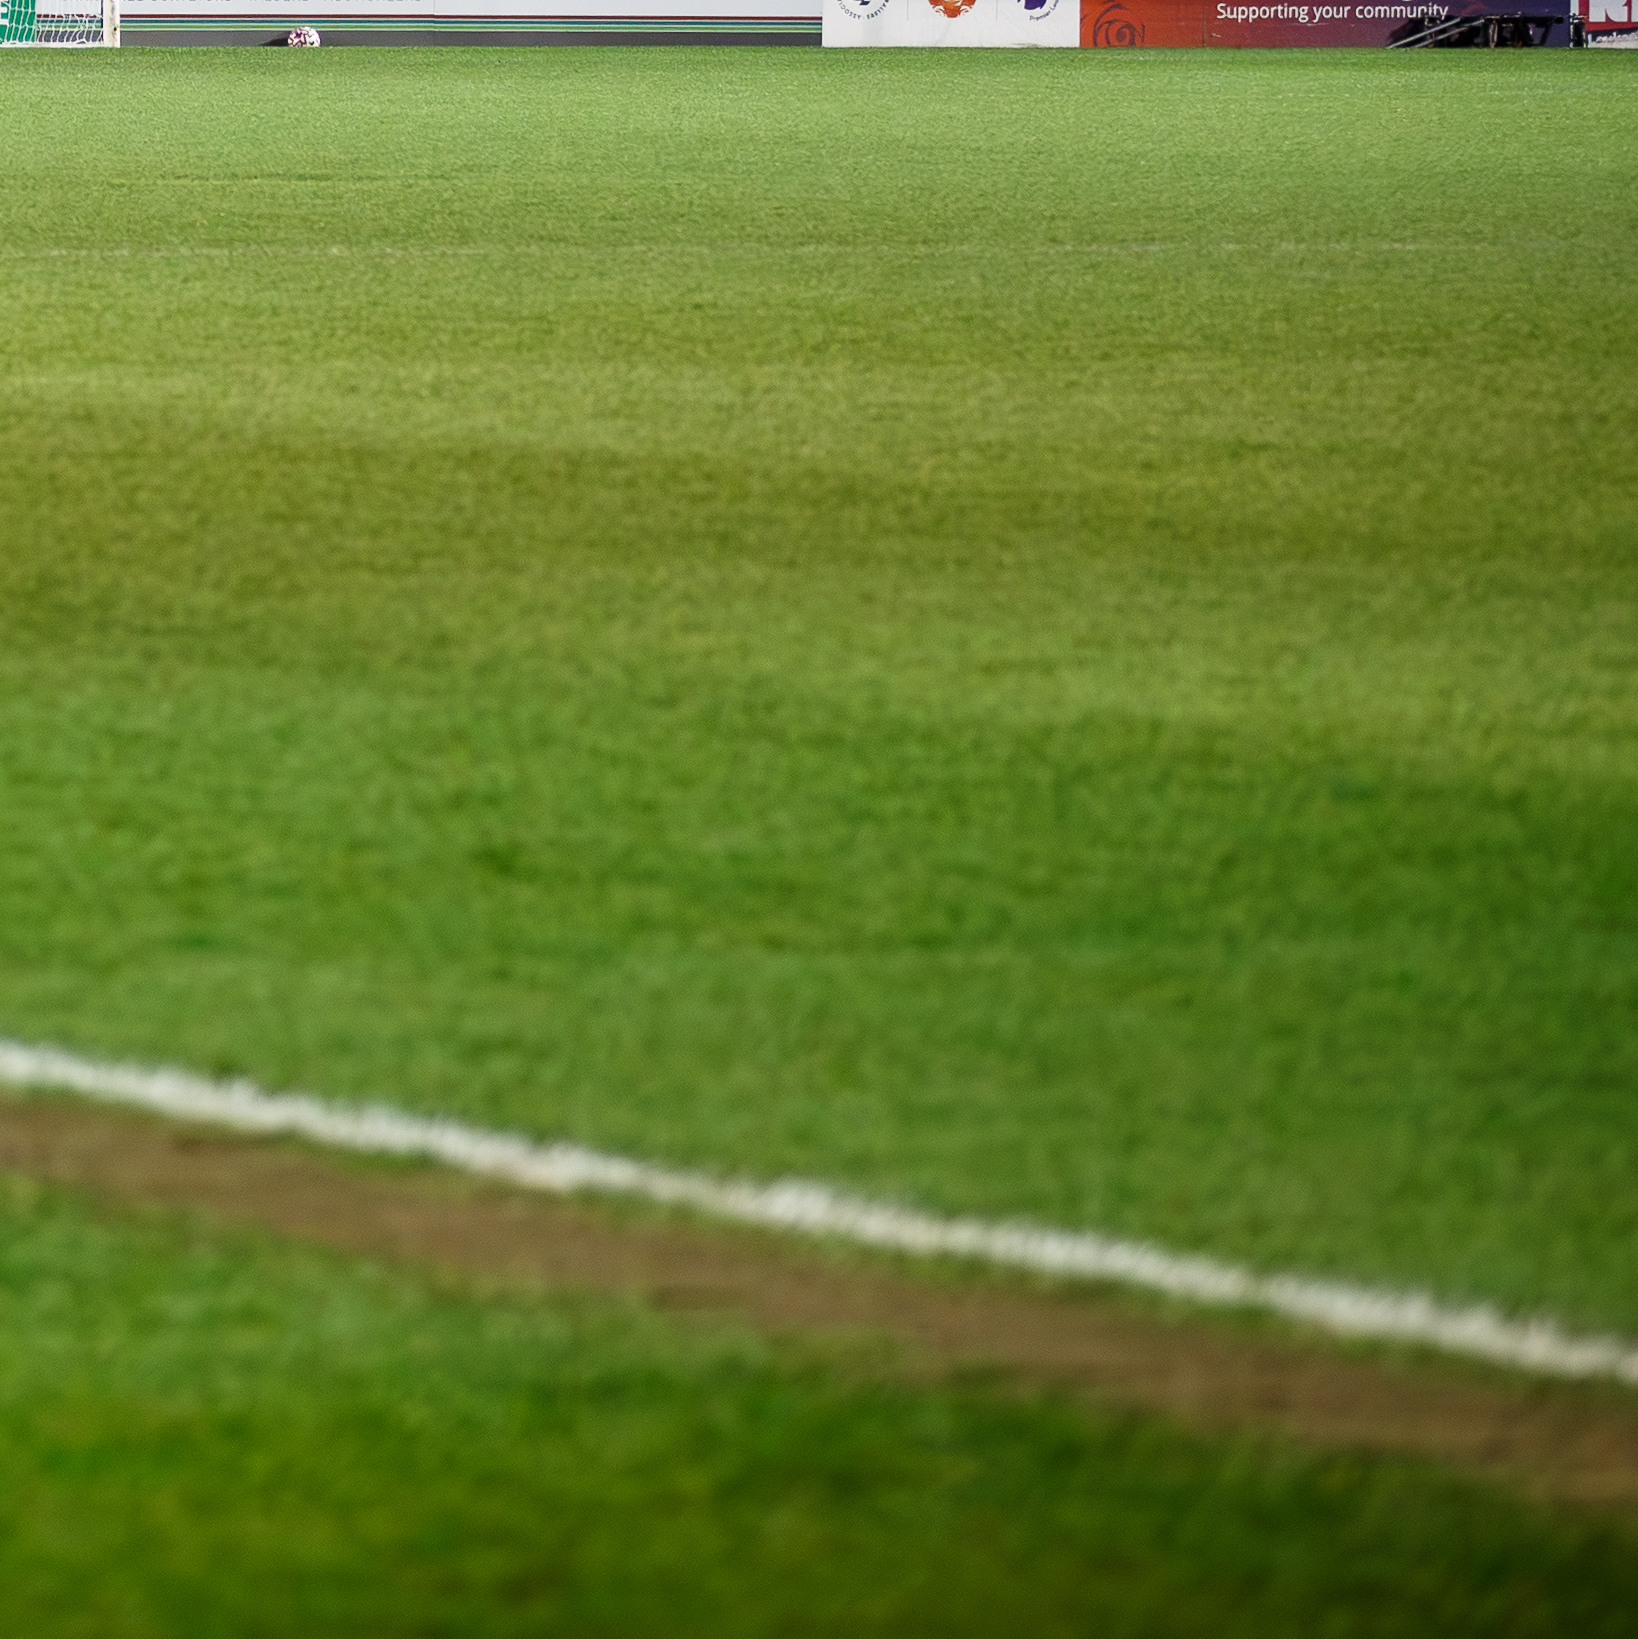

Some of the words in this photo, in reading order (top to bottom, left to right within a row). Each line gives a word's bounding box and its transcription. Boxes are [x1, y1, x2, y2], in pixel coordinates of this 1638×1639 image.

[1216, 2, 1310, 24] Supporting
[1312, 7, 1352, 24] your
[1355, 2, 1449, 20] community
